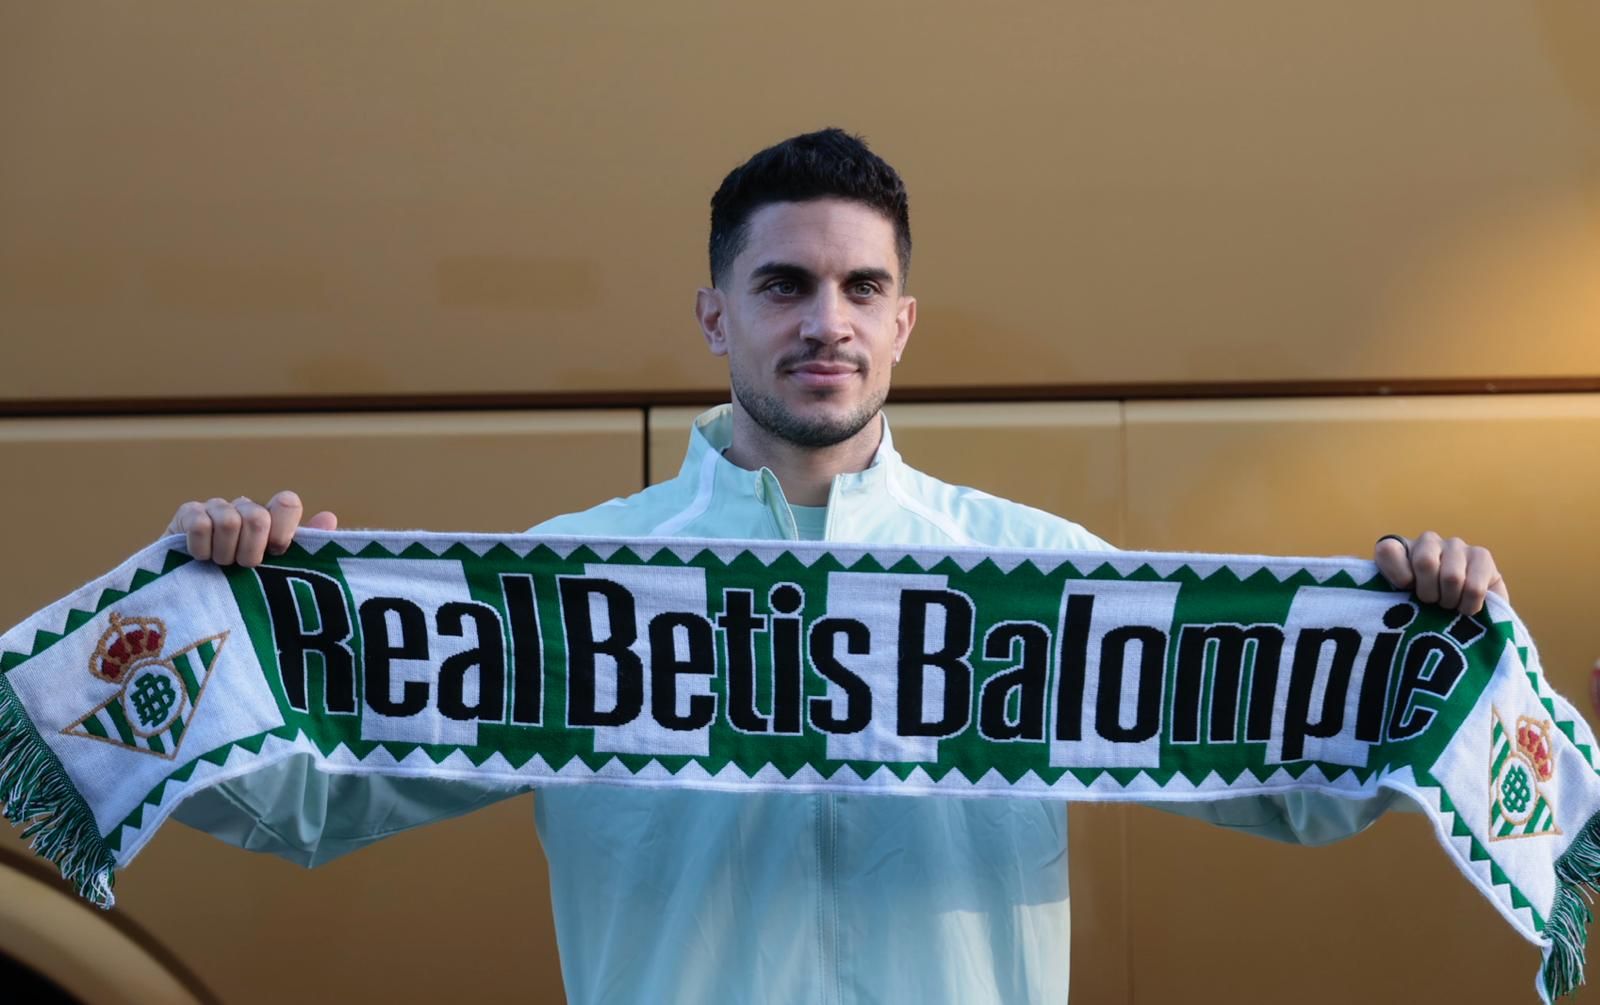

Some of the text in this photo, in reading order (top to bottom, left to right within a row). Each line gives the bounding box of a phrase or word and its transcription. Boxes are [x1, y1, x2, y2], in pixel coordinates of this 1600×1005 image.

[254, 565, 1487, 763] Real Betis Balompié
